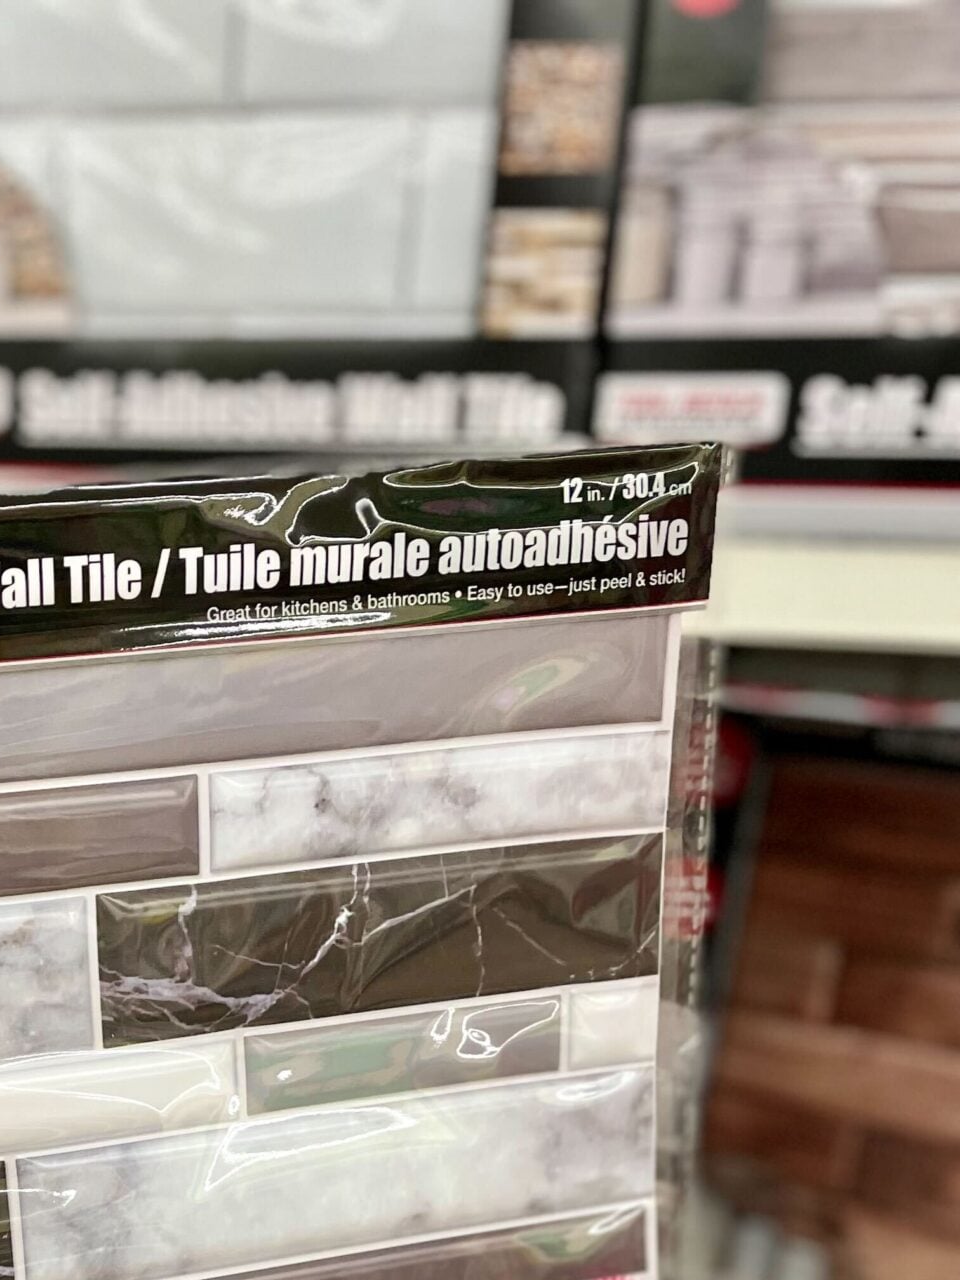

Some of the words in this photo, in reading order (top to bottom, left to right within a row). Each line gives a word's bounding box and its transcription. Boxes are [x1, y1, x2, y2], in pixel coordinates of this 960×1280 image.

[560, 477, 583, 504] 12
[587, 485, 605, 502] in.
[609, 476, 618, 500] /
[622, 472, 665, 500] 30.4
[668, 481, 692, 497] cm
[63, 553, 142, 604] Tile
[151, 548, 171, 598] /
[179, 543, 281, 595] Tuile
[290, 532, 430, 587] murale
[438, 514, 689, 576] autoadhésive
[207, 606, 251, 623] Great
[255, 603, 277, 618] for
[281, 597, 348, 616] kitchens
[352, 595, 363, 610] &
[368, 590, 450, 609] bathrooms
[467, 585, 502, 603] Easy
[507, 582, 523, 598] to
[600, 573, 632, 593] peel
[635, 571, 646, 587] &
[649, 568, 686, 586] stick!
